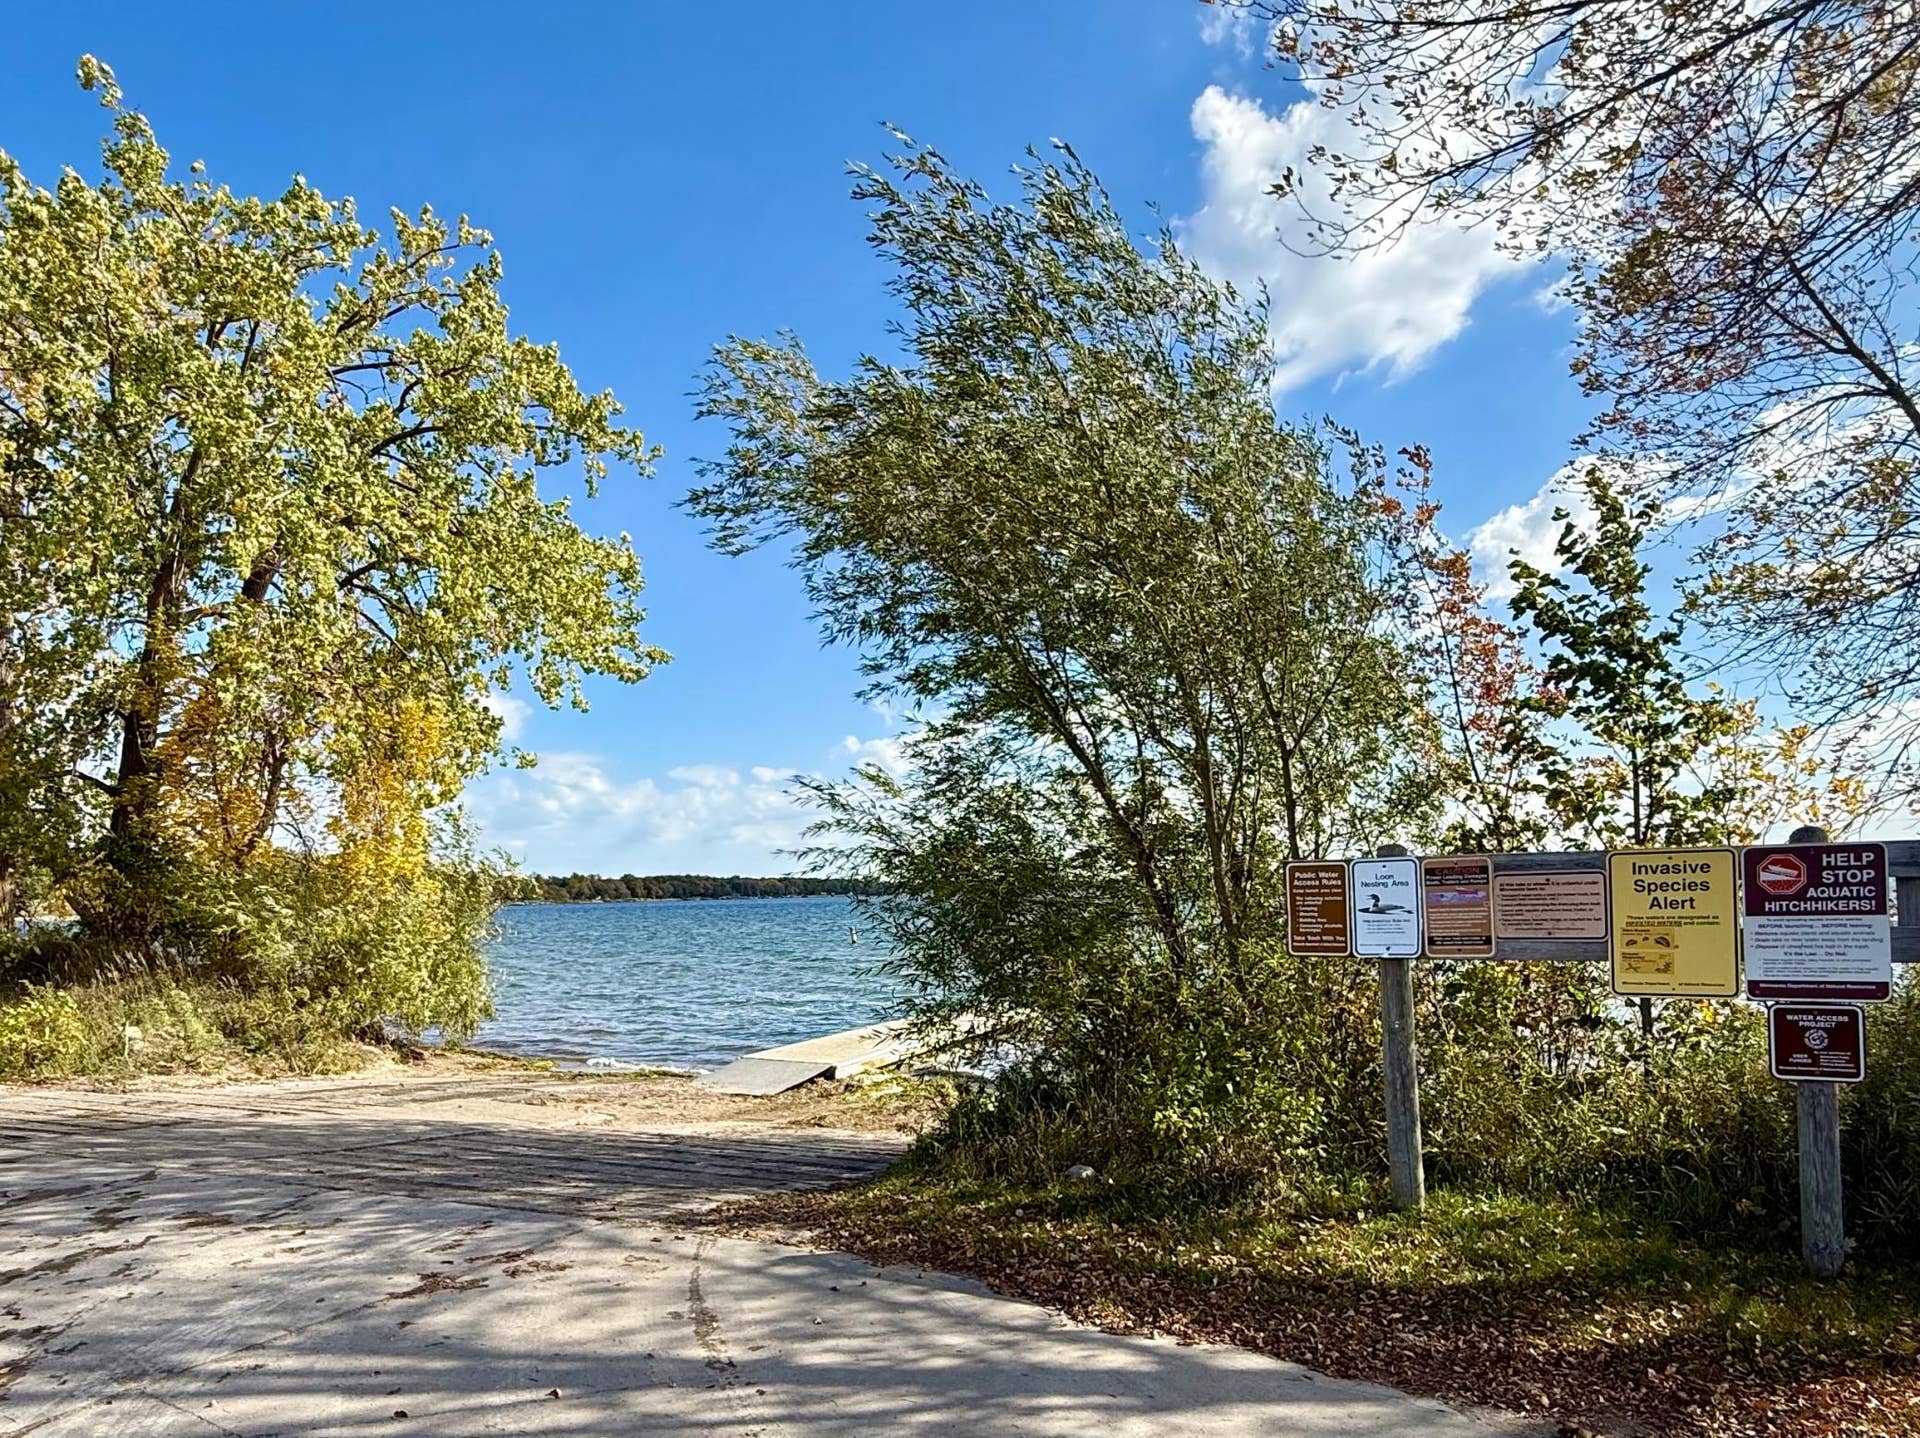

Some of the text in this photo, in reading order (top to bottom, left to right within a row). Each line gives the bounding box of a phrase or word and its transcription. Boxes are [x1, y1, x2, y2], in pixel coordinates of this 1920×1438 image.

[1822, 852, 1875, 866] HELP
[1632, 860, 1711, 875] Invasive
[1822, 870, 1875, 884] STOP
[1634, 878, 1710, 896] Species
[1806, 886, 1876, 898] AQUATIC
[1648, 896, 1696, 910] Alert
[1764, 900, 1876, 912] HITCHHIKERS!
